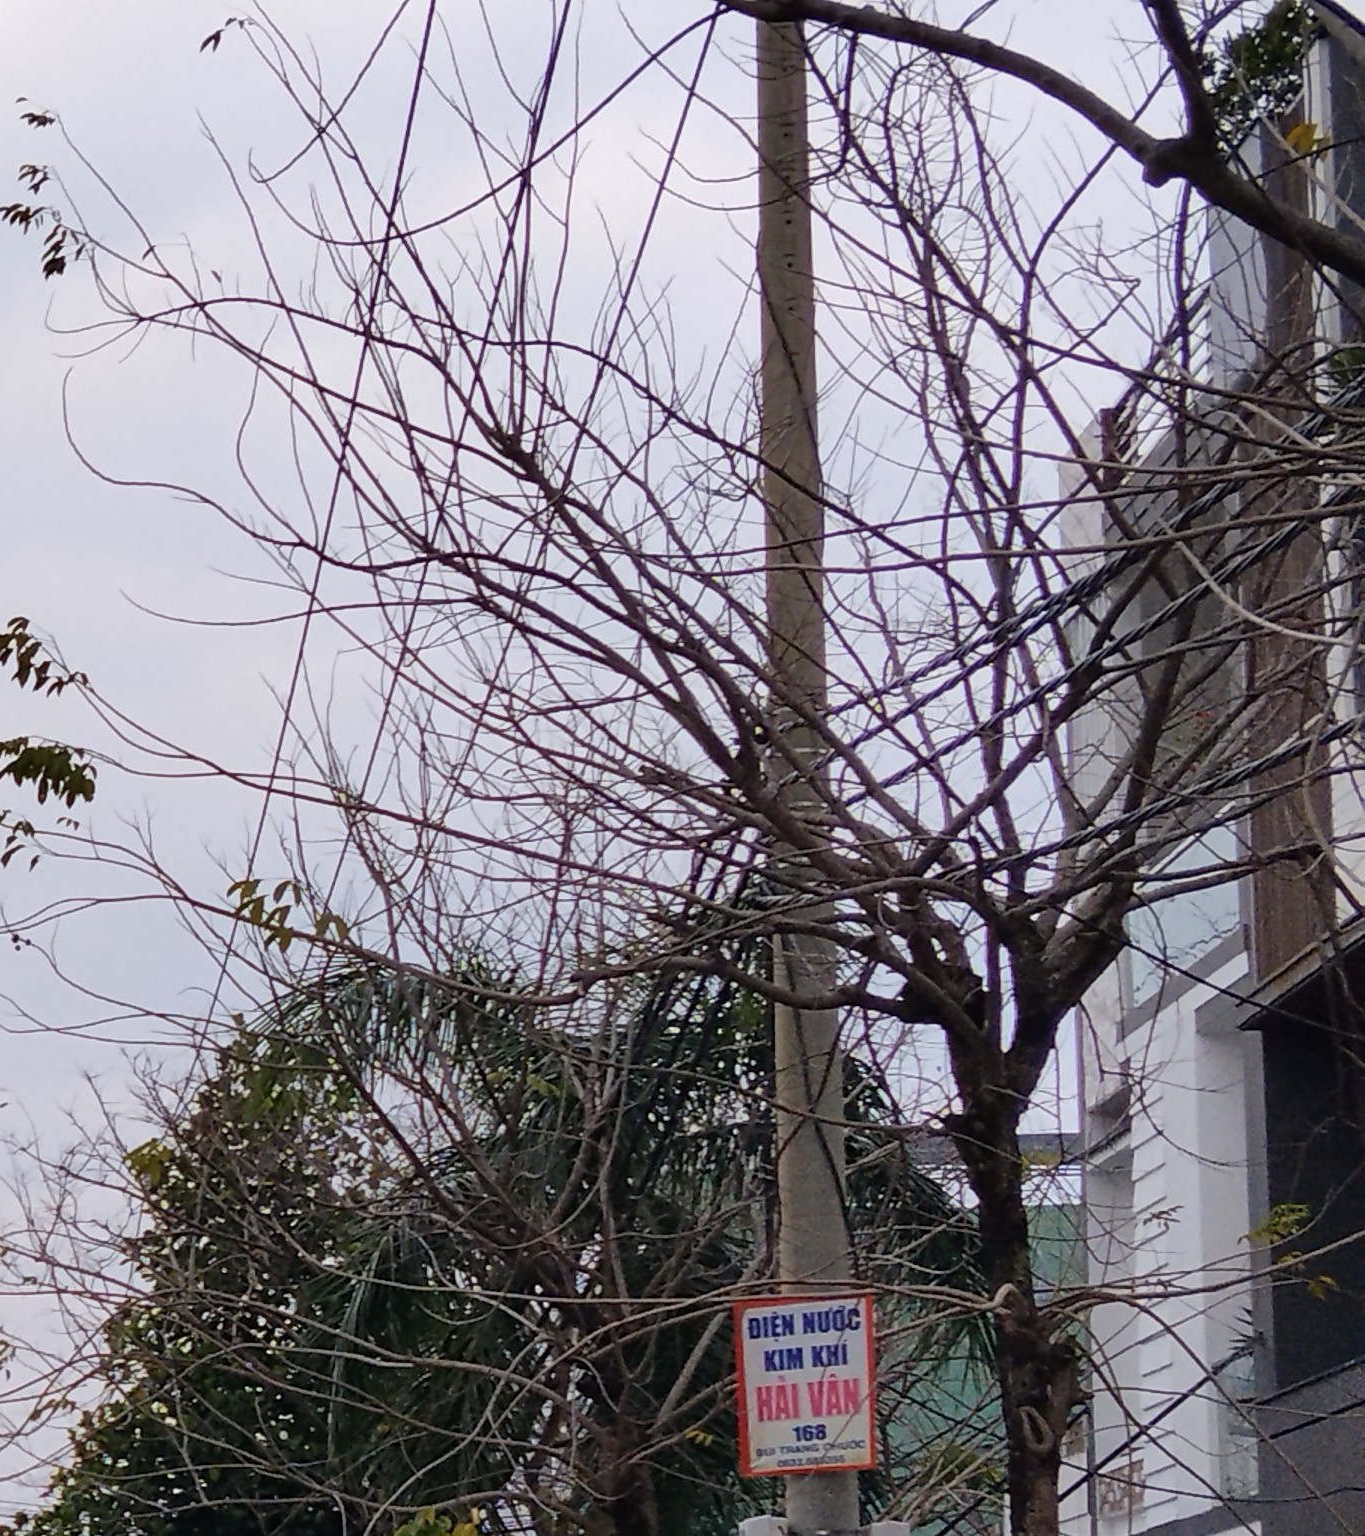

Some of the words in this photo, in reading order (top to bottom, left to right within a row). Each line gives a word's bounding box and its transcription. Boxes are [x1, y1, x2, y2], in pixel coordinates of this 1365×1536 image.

[747, 1310, 795, 1342] ĐIỆN
[802, 1304, 861, 1335] NƯỚC
[764, 1346, 804, 1372] KIM
[811, 1338, 849, 1367] KHÍ
[755, 1374, 800, 1422] HẢI
[806, 1372, 862, 1419] VÂN
[792, 1424, 827, 1442] 168
